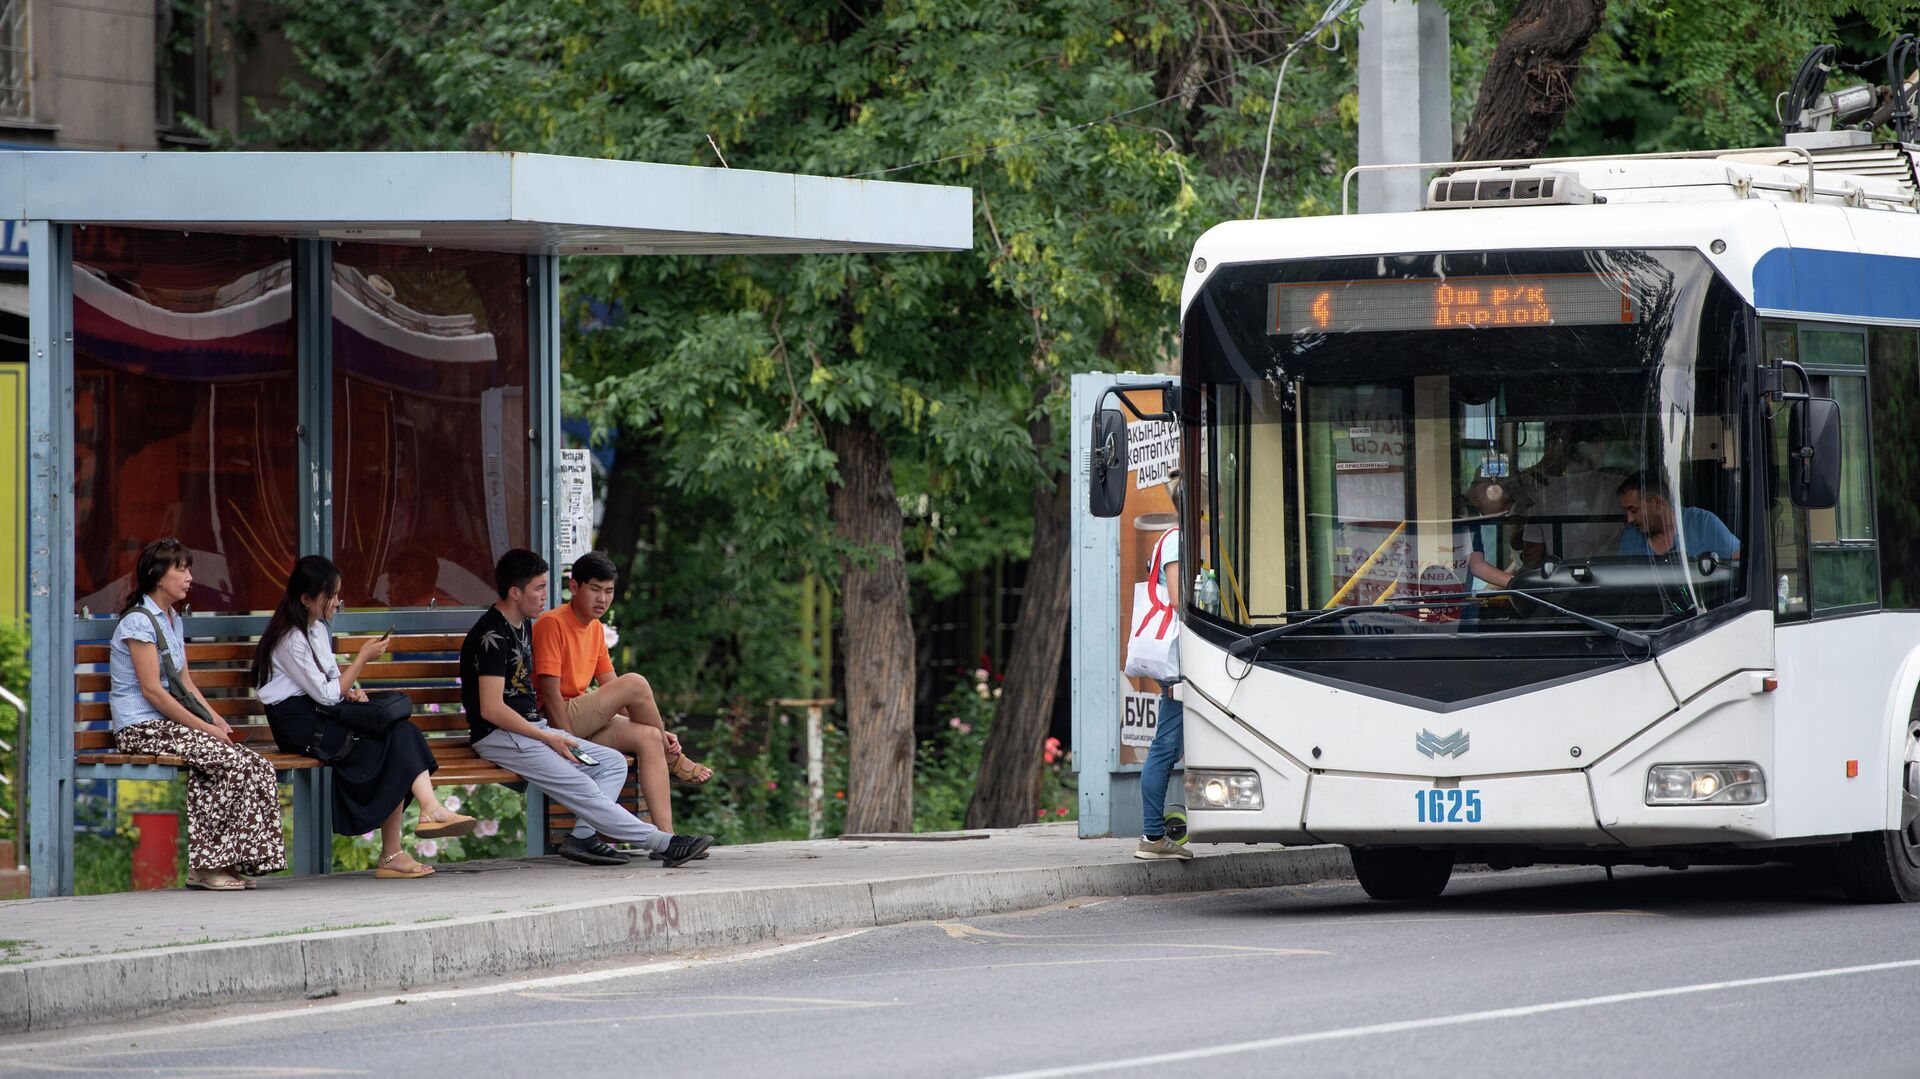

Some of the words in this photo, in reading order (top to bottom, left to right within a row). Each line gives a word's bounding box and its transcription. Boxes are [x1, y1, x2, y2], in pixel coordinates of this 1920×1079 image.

[1438, 286, 1478, 305] Ош
[1127, 421, 1166, 444] АКЫНДА
[1125, 696, 1160, 728] БУБ
[1415, 789, 1482, 823] 1625
